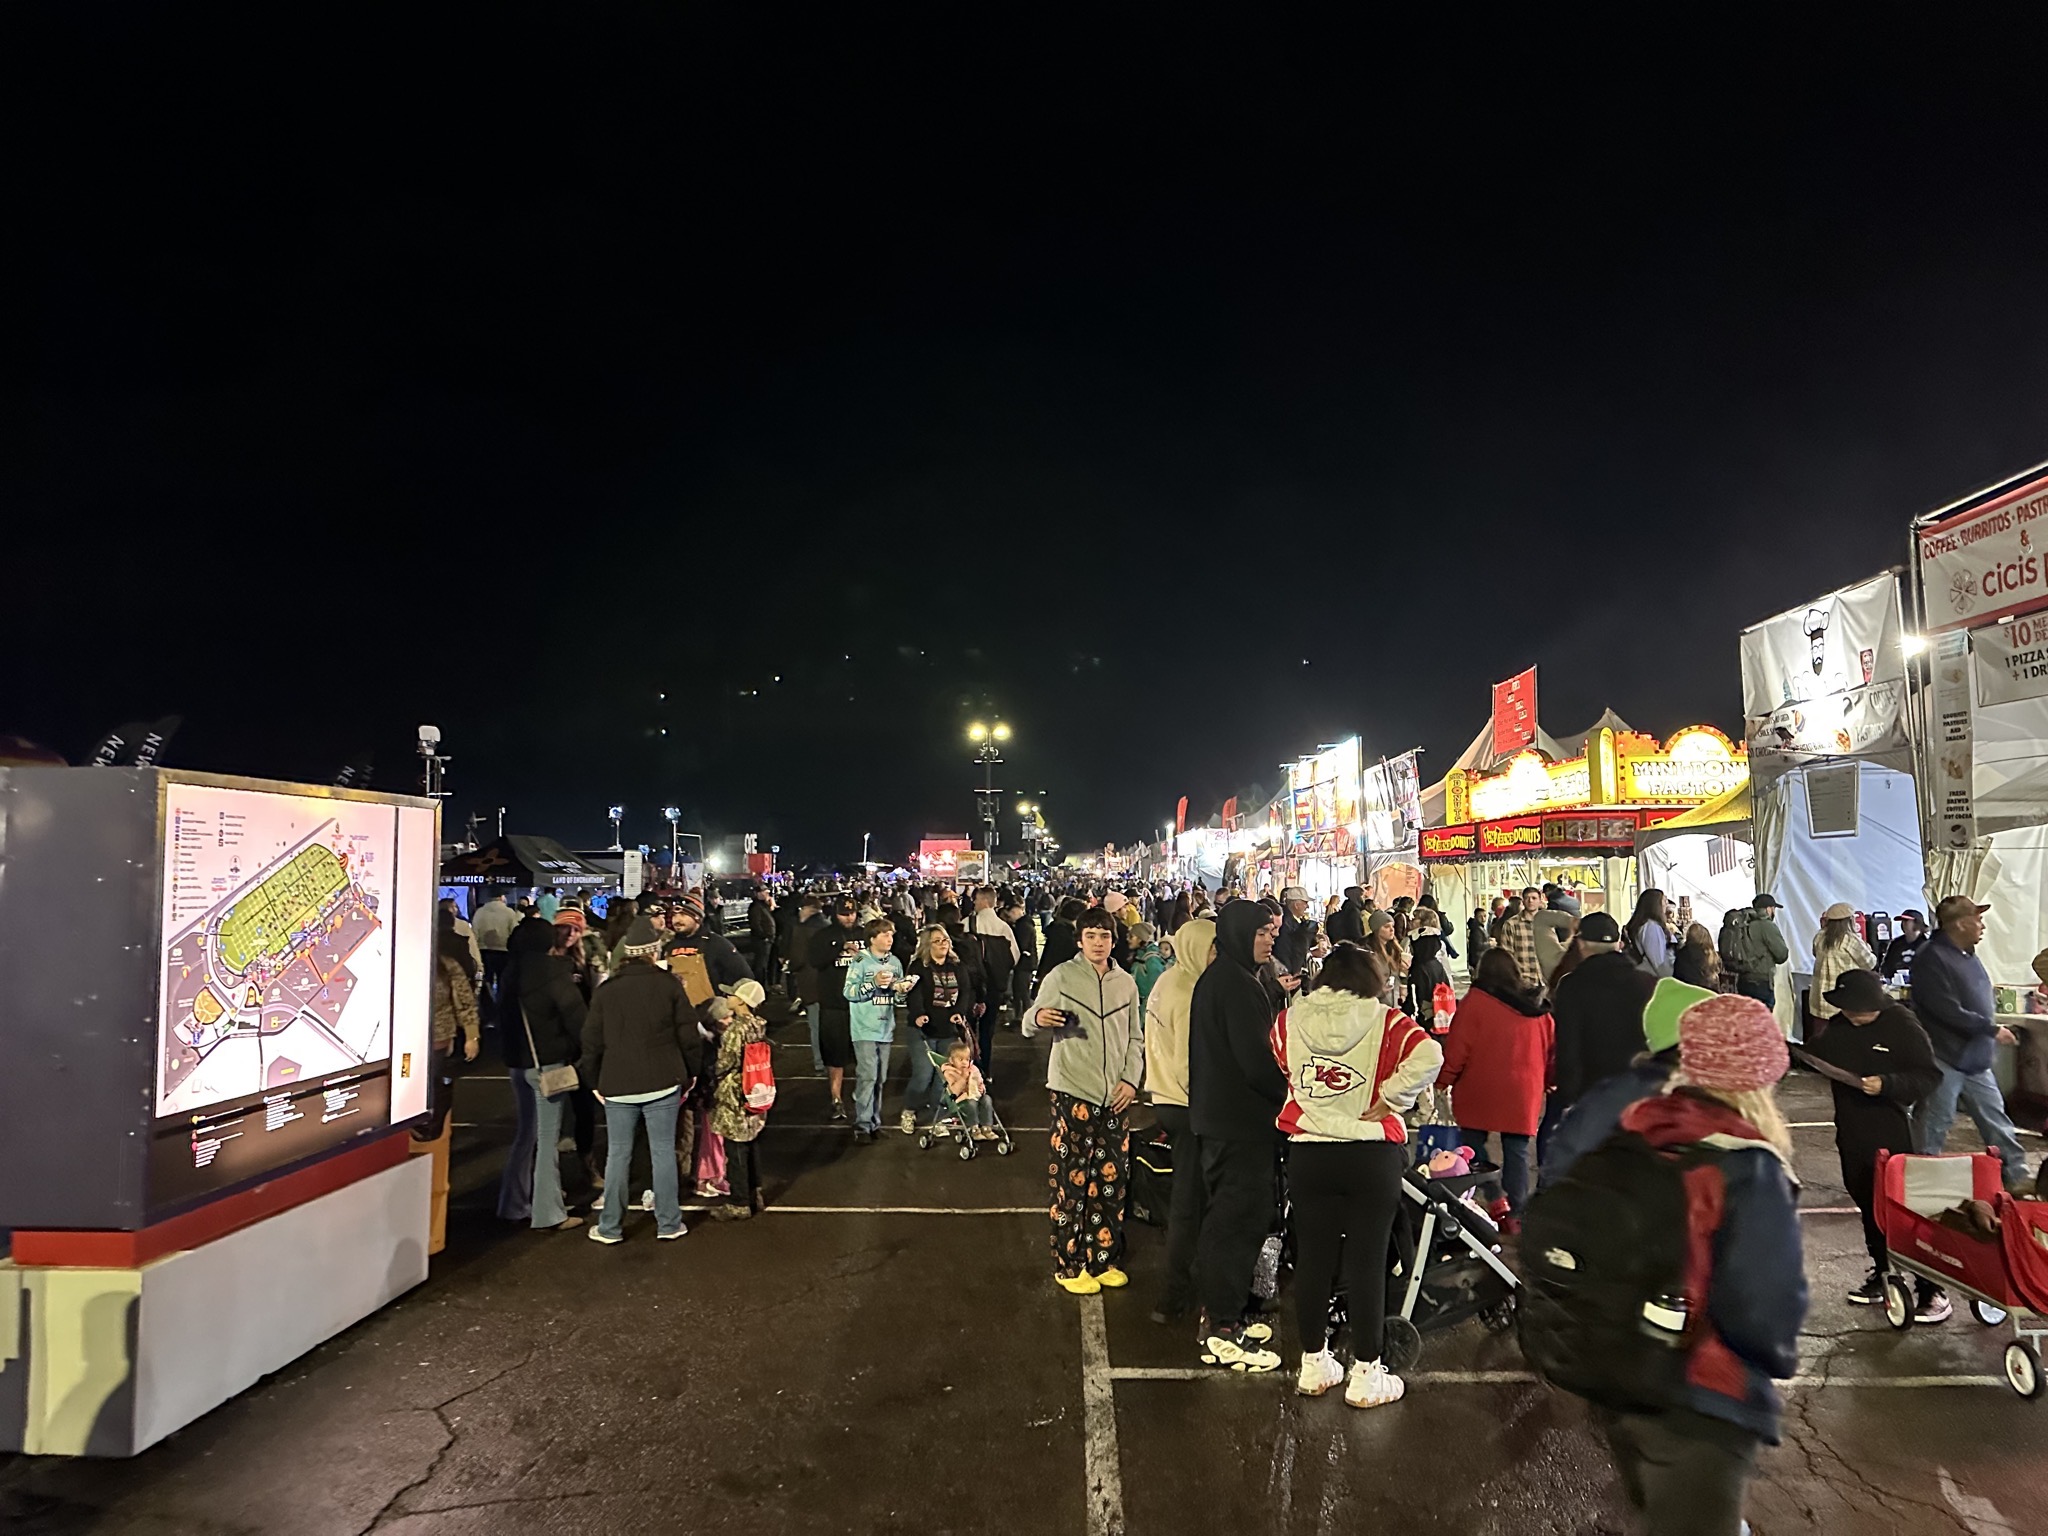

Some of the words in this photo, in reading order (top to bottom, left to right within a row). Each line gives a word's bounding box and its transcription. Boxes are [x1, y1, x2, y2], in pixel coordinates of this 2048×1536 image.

[1924, 534, 1958, 559] COFFEE
[1960, 511, 2011, 546] BURRITOS
[2020, 530, 2030, 547] &
[1982, 555, 2038, 597] cicis
[2004, 621, 2031, 649] $10
[2011, 649, 2045, 667] PIZZA
[1942, 719, 1968, 727] PASTRIES
[1450, 834, 1476, 850] DONUTS
[1513, 826, 1541, 844] DONUTS
[440, 875, 452, 883] EW
[453, 875, 485, 883] MEXICO
[495, 876, 517, 884] TRUE
[1314, 1065, 1352, 1090] KC
